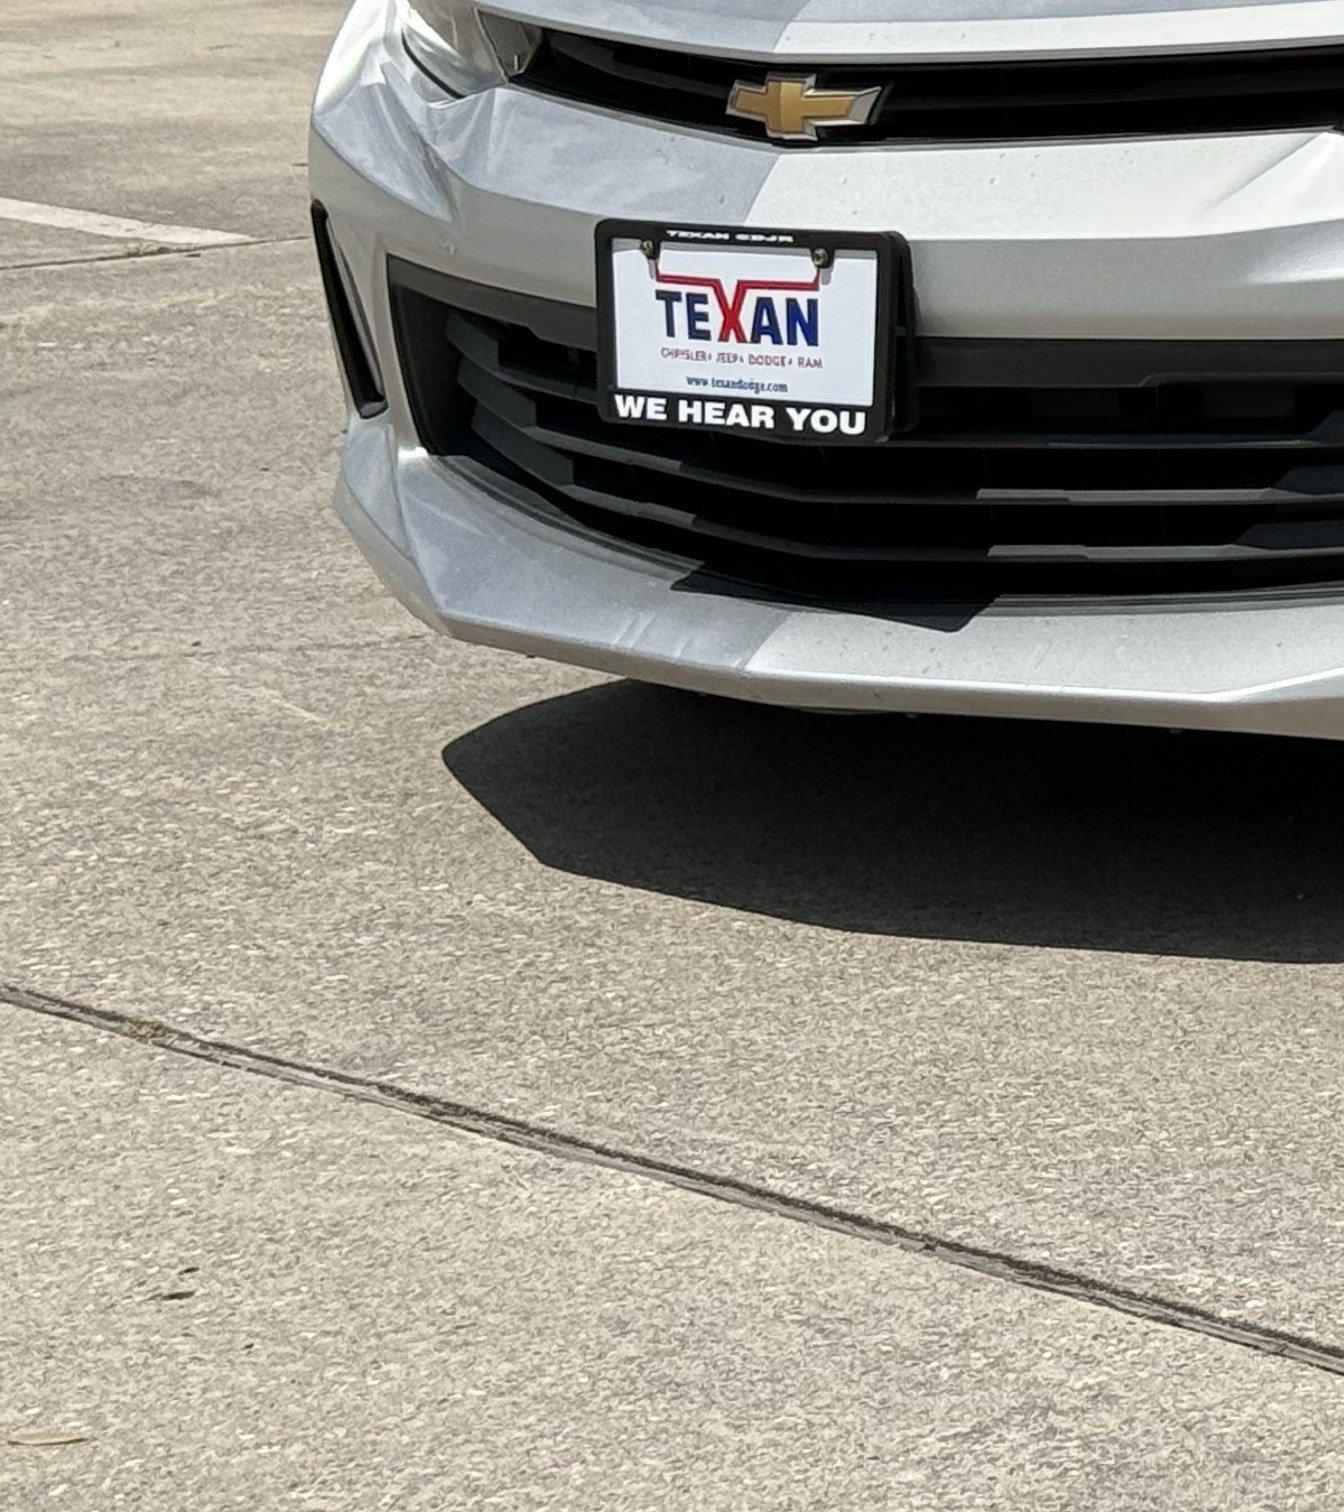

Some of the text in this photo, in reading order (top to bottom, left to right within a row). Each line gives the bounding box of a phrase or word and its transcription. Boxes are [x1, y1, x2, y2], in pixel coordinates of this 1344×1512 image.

[665, 229, 730, 240] TEXAN
[655, 273, 819, 346] TEXAN
[748, 354, 786, 367] DODGE
[797, 356, 823, 369] RAM
[614, 393, 866, 435] WE HEAR YOU
